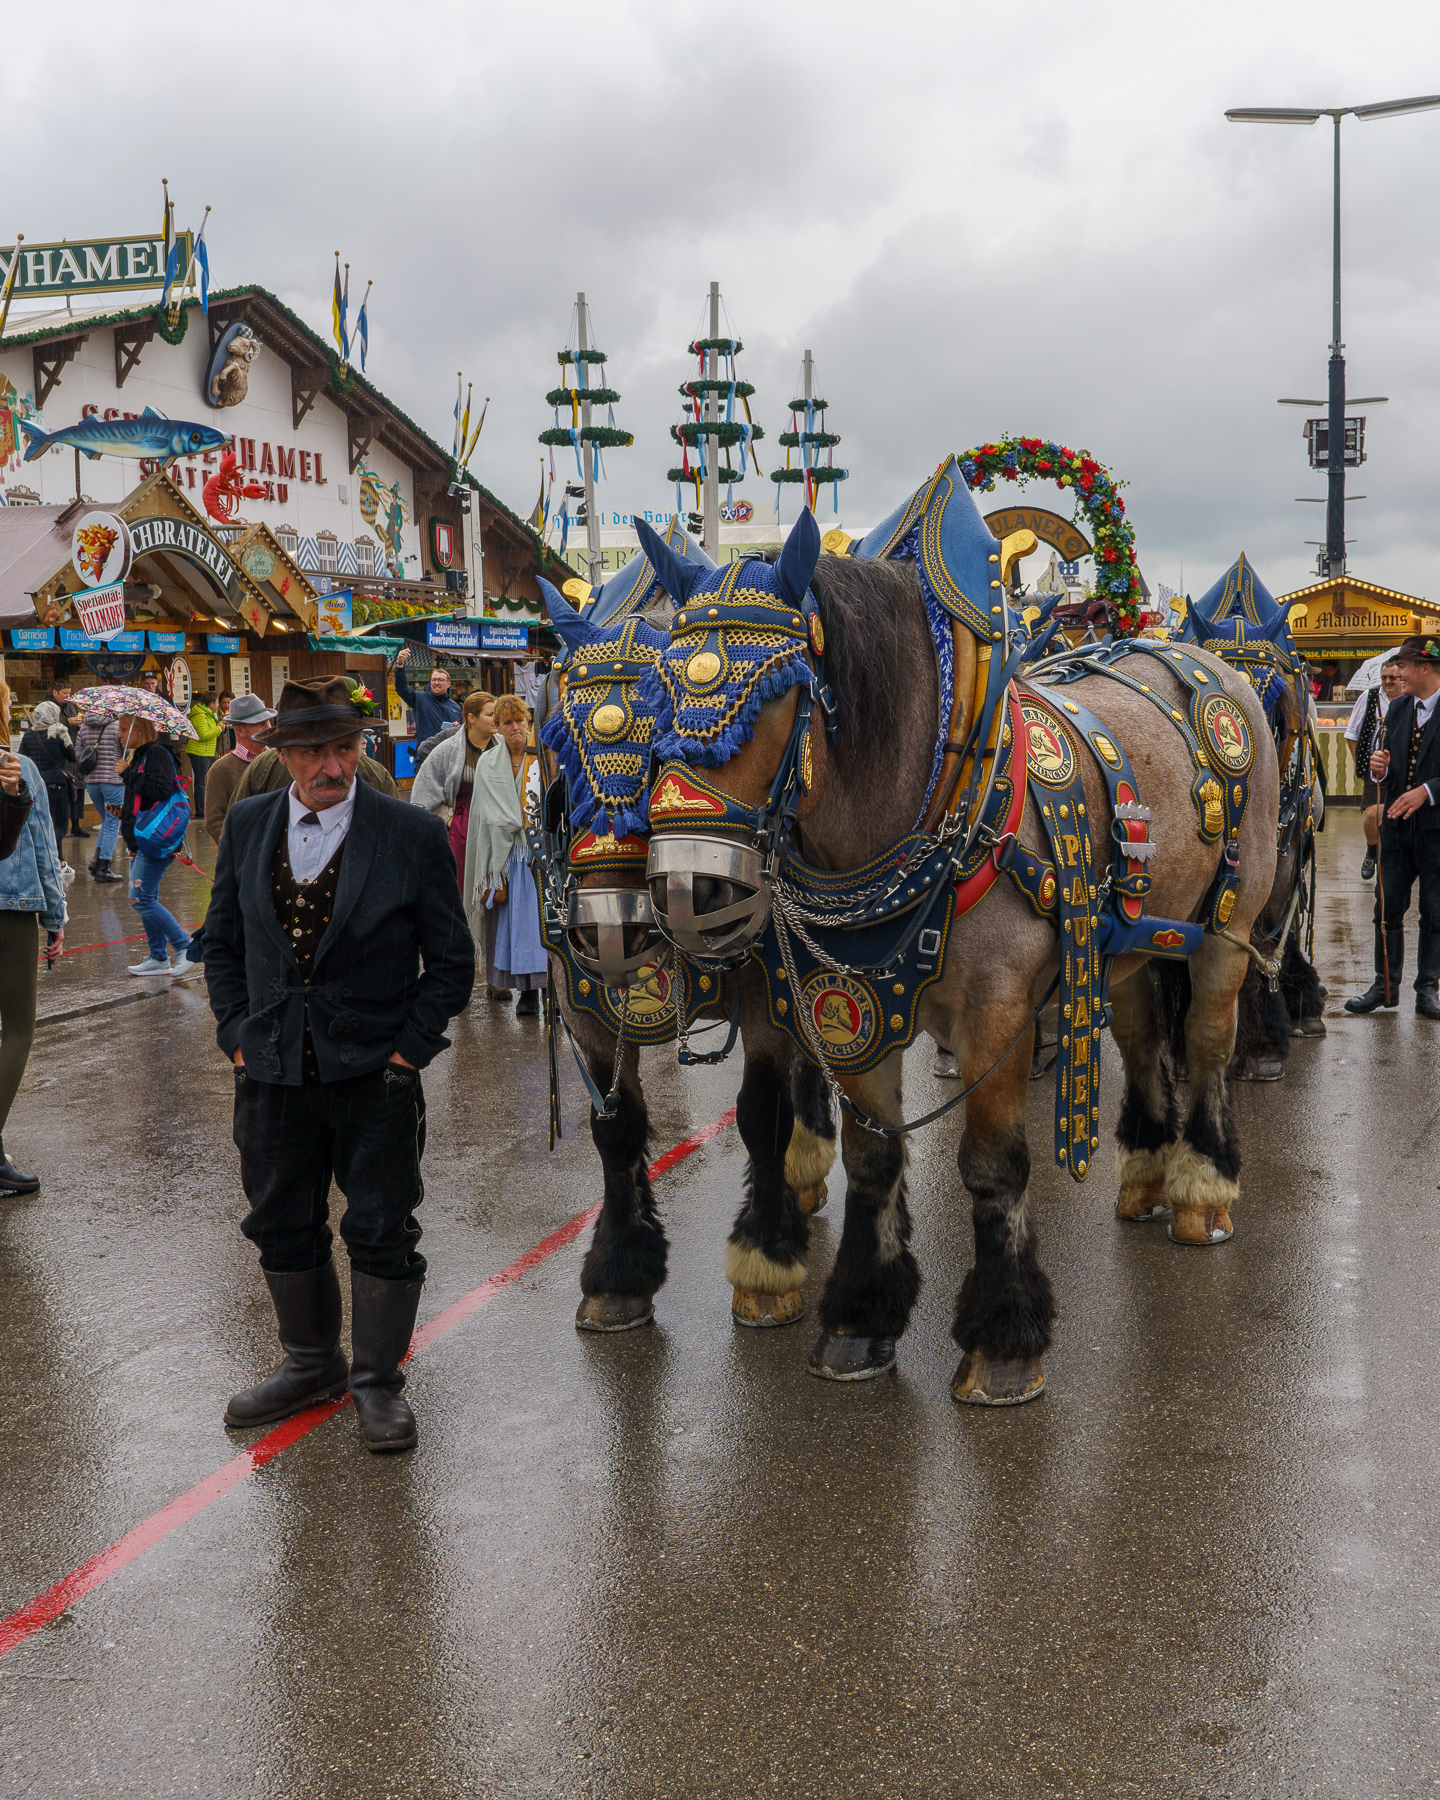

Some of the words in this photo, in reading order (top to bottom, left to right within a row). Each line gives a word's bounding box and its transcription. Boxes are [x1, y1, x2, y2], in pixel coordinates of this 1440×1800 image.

[613, 512, 635, 525] der
[77, 589, 121, 611] Spezialität:
[18, 629, 48, 640] Garnelen
[1207, 701, 1245, 730] PAULANER
[803, 976, 870, 1013] PAULANER
[1062, 834, 1089, 1144] PAULANER
